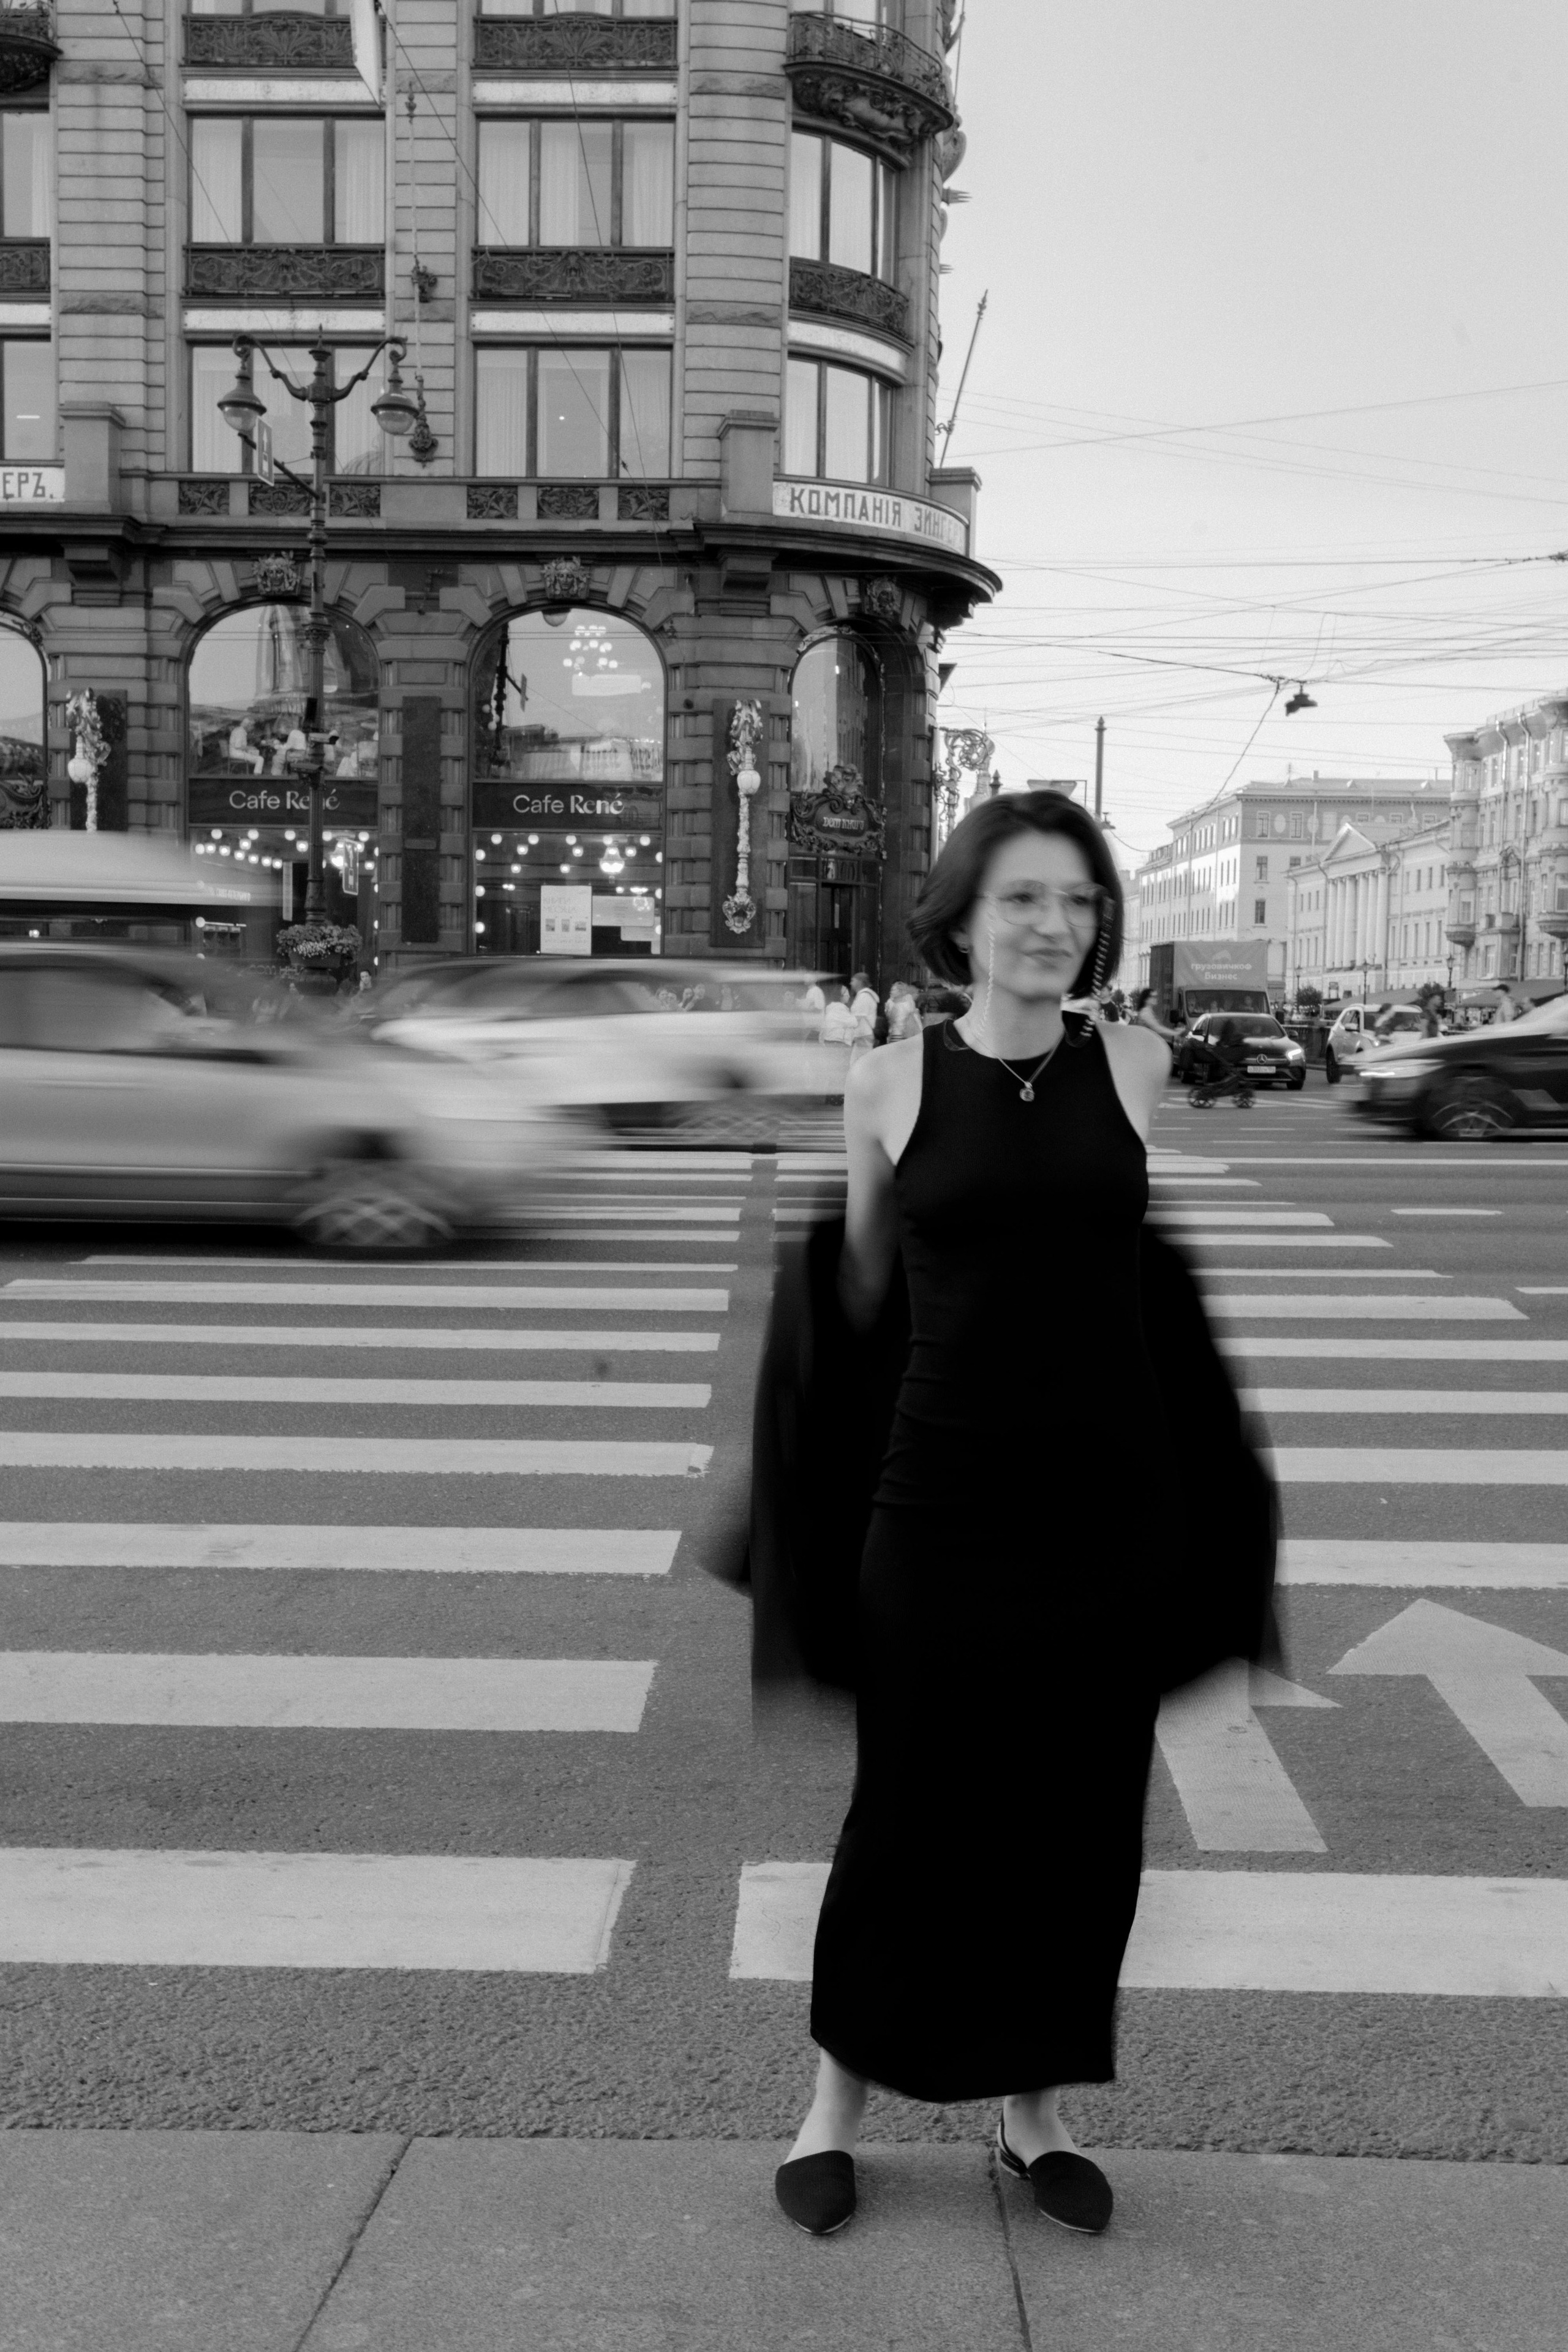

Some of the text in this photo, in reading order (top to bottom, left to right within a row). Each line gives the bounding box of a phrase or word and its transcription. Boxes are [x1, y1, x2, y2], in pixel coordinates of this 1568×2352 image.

[790, 488, 901, 527] КОМПАНІЯ
[229, 789, 340, 810] Cafe Reé
[513, 793, 625, 814] Cafe René
